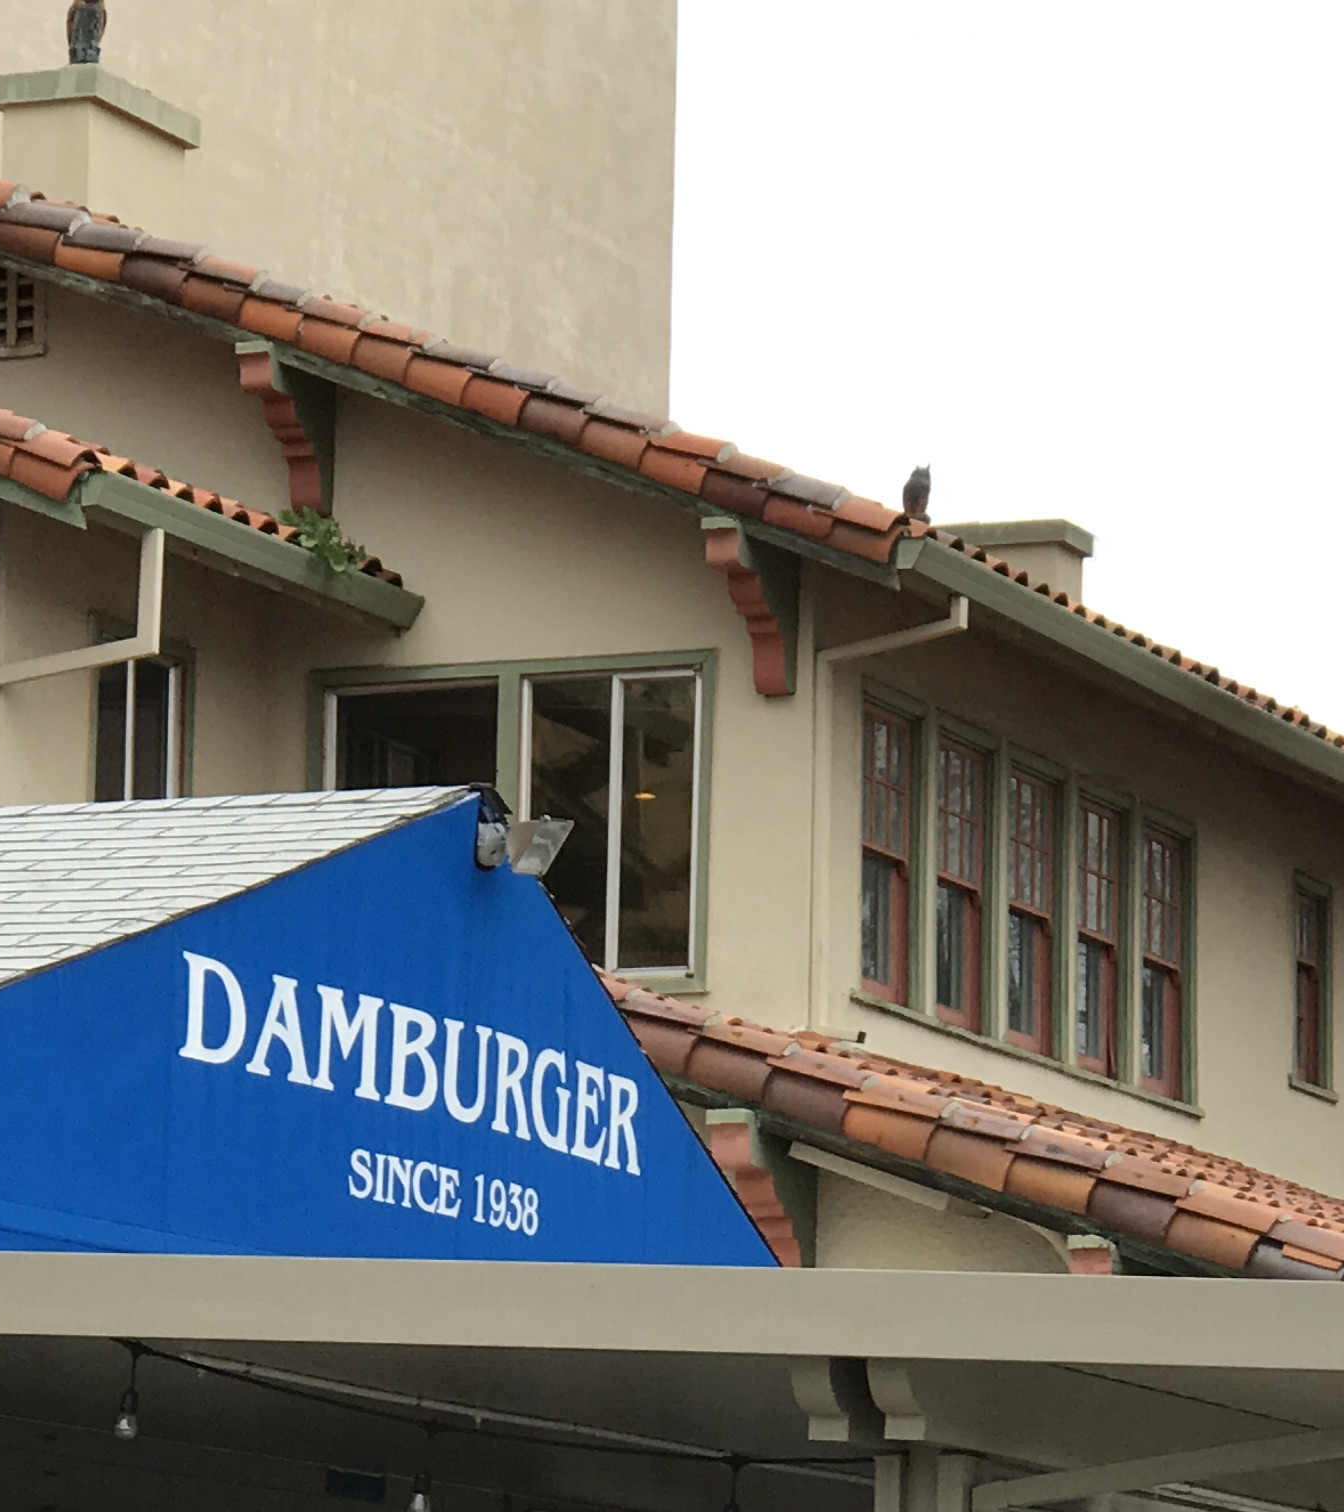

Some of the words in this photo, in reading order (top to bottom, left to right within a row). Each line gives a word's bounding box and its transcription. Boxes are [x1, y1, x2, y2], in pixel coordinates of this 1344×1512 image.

[179, 949, 643, 1177] DAMBURGER
[348, 1148, 462, 1219] SINCE
[473, 1174, 539, 1237] 1938
